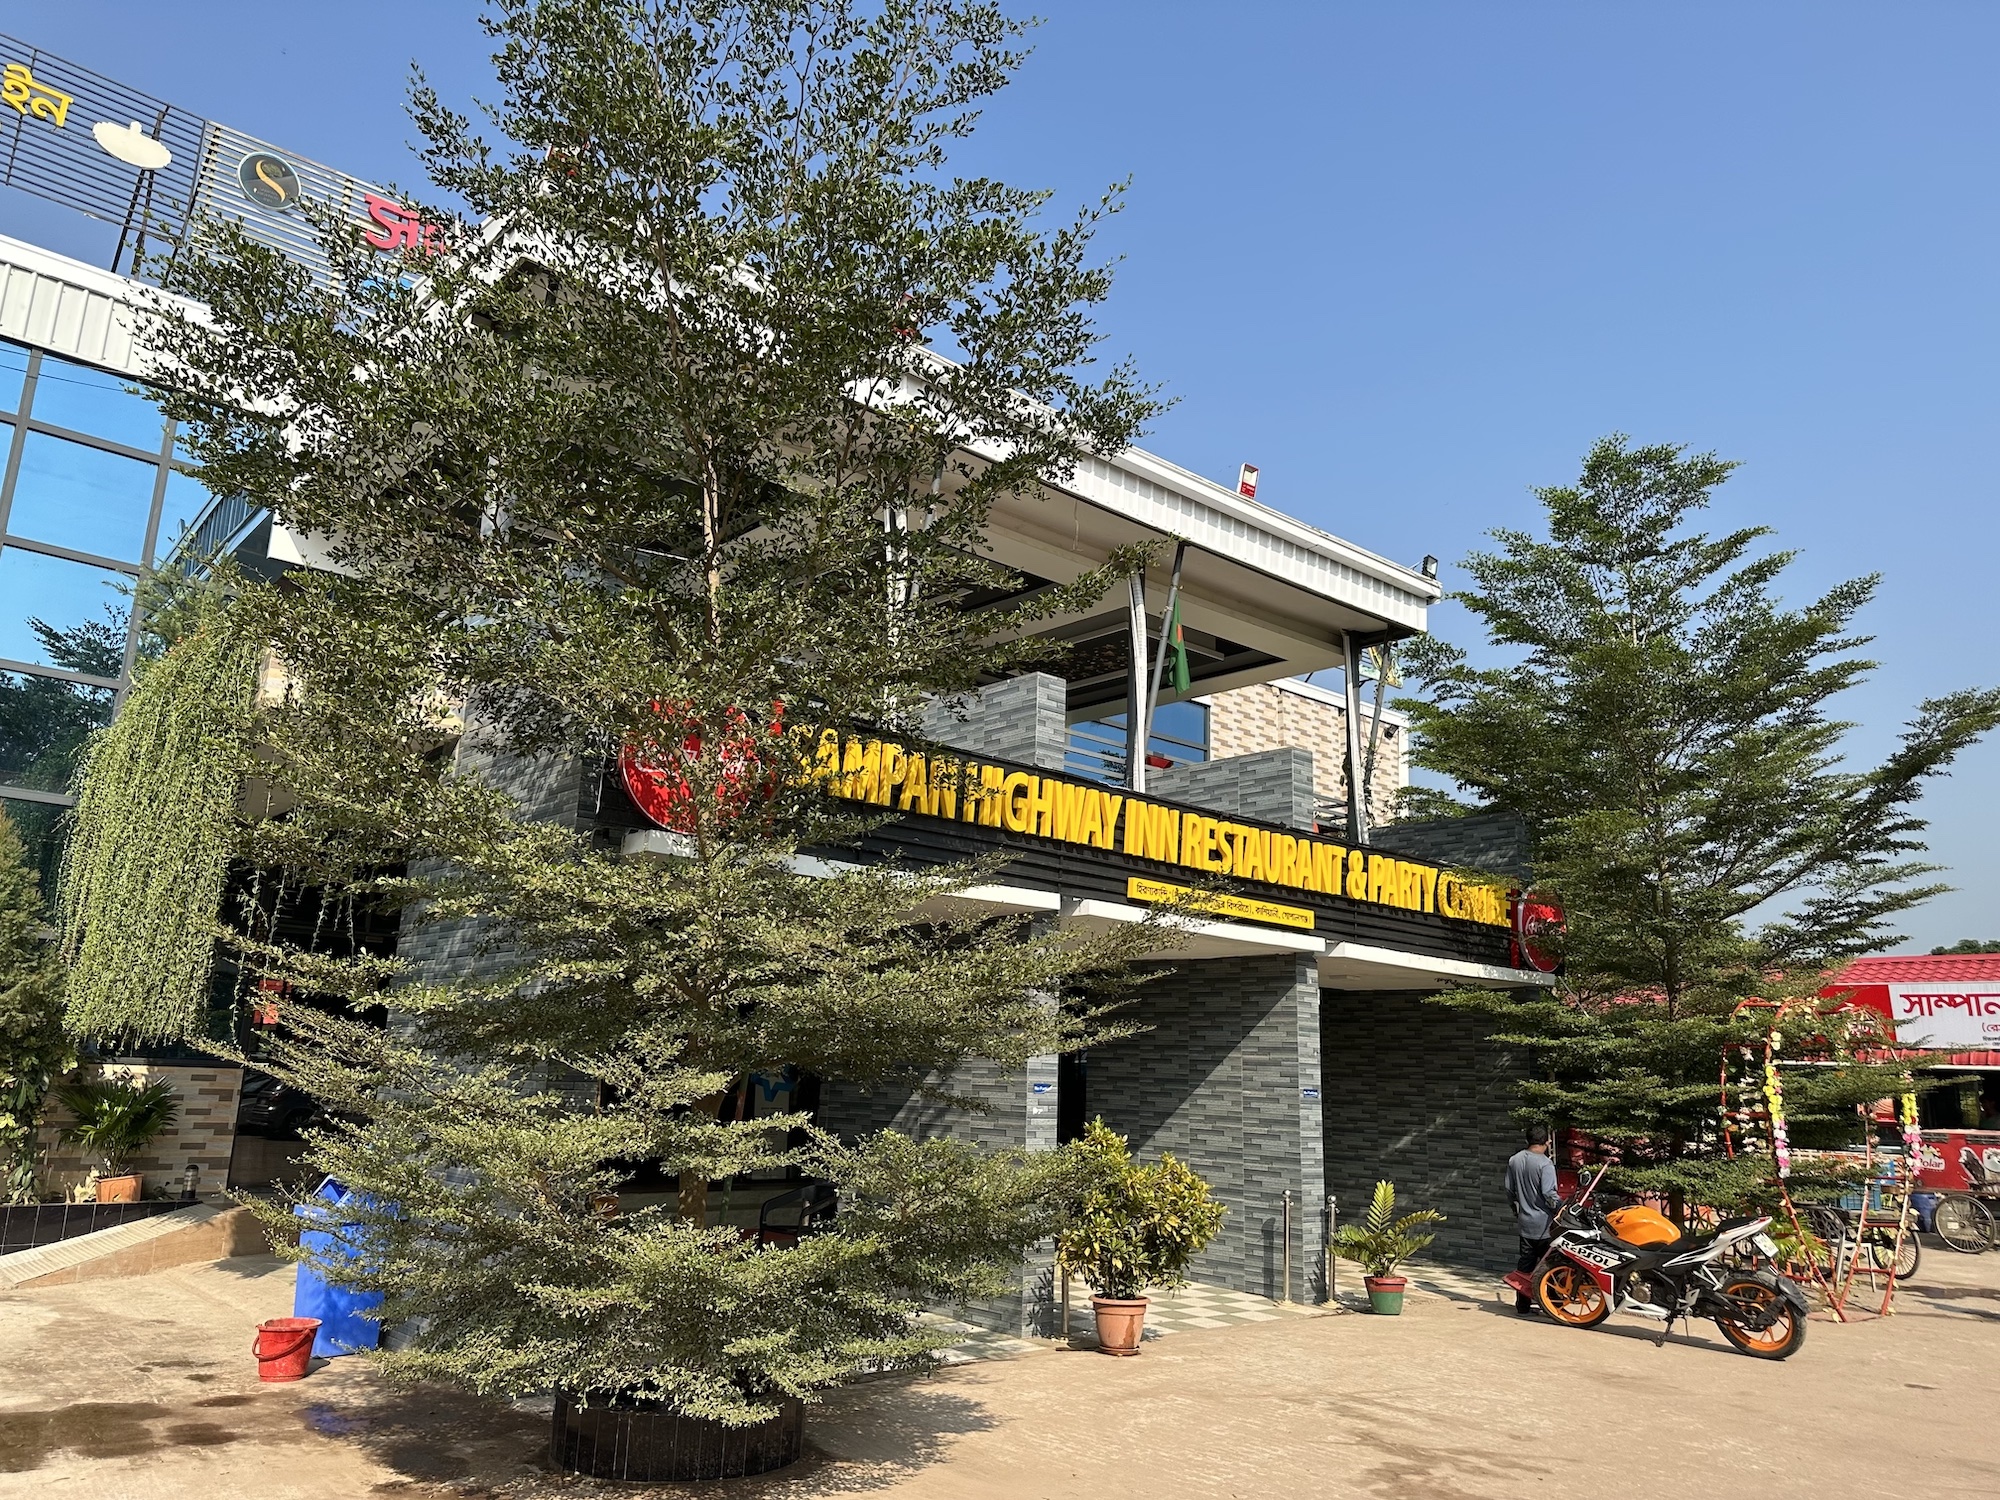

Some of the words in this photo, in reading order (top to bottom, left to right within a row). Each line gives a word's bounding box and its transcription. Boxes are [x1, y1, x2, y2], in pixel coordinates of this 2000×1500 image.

[2, 64, 74, 127] ইন
[962, 761, 1123, 850] HIGHWAY
[1123, 798, 1180, 864] INN
[1180, 813, 1347, 896] RESTAURANT
[1347, 849, 1368, 900] &
[1367, 853, 1438, 913] PARTY
[1919, 1157, 1943, 1168] olar
